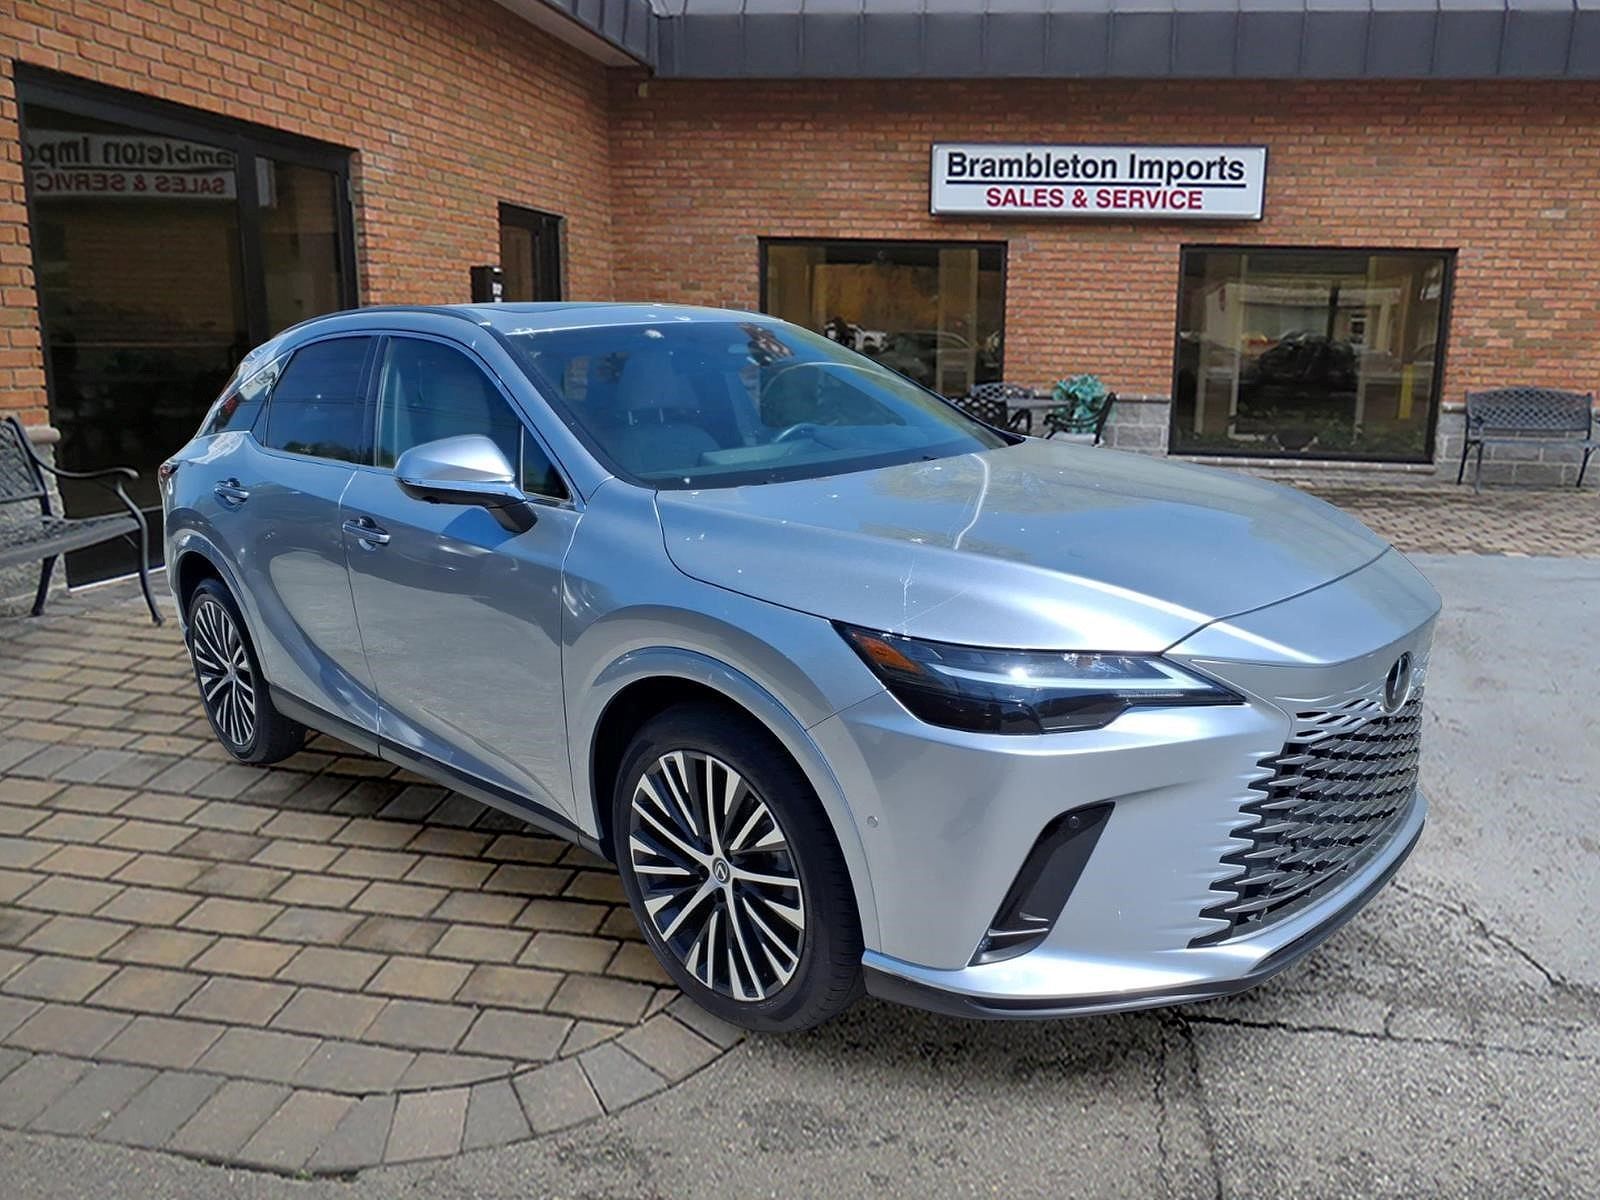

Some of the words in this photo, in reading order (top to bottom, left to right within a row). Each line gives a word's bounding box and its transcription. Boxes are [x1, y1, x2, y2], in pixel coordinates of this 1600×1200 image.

[948, 152, 1117, 179] Brambleton
[1129, 154, 1245, 187] Imports
[986, 187, 1064, 208] SALES
[1071, 189, 1088, 208] &
[1096, 190, 1203, 210] SERVICE
